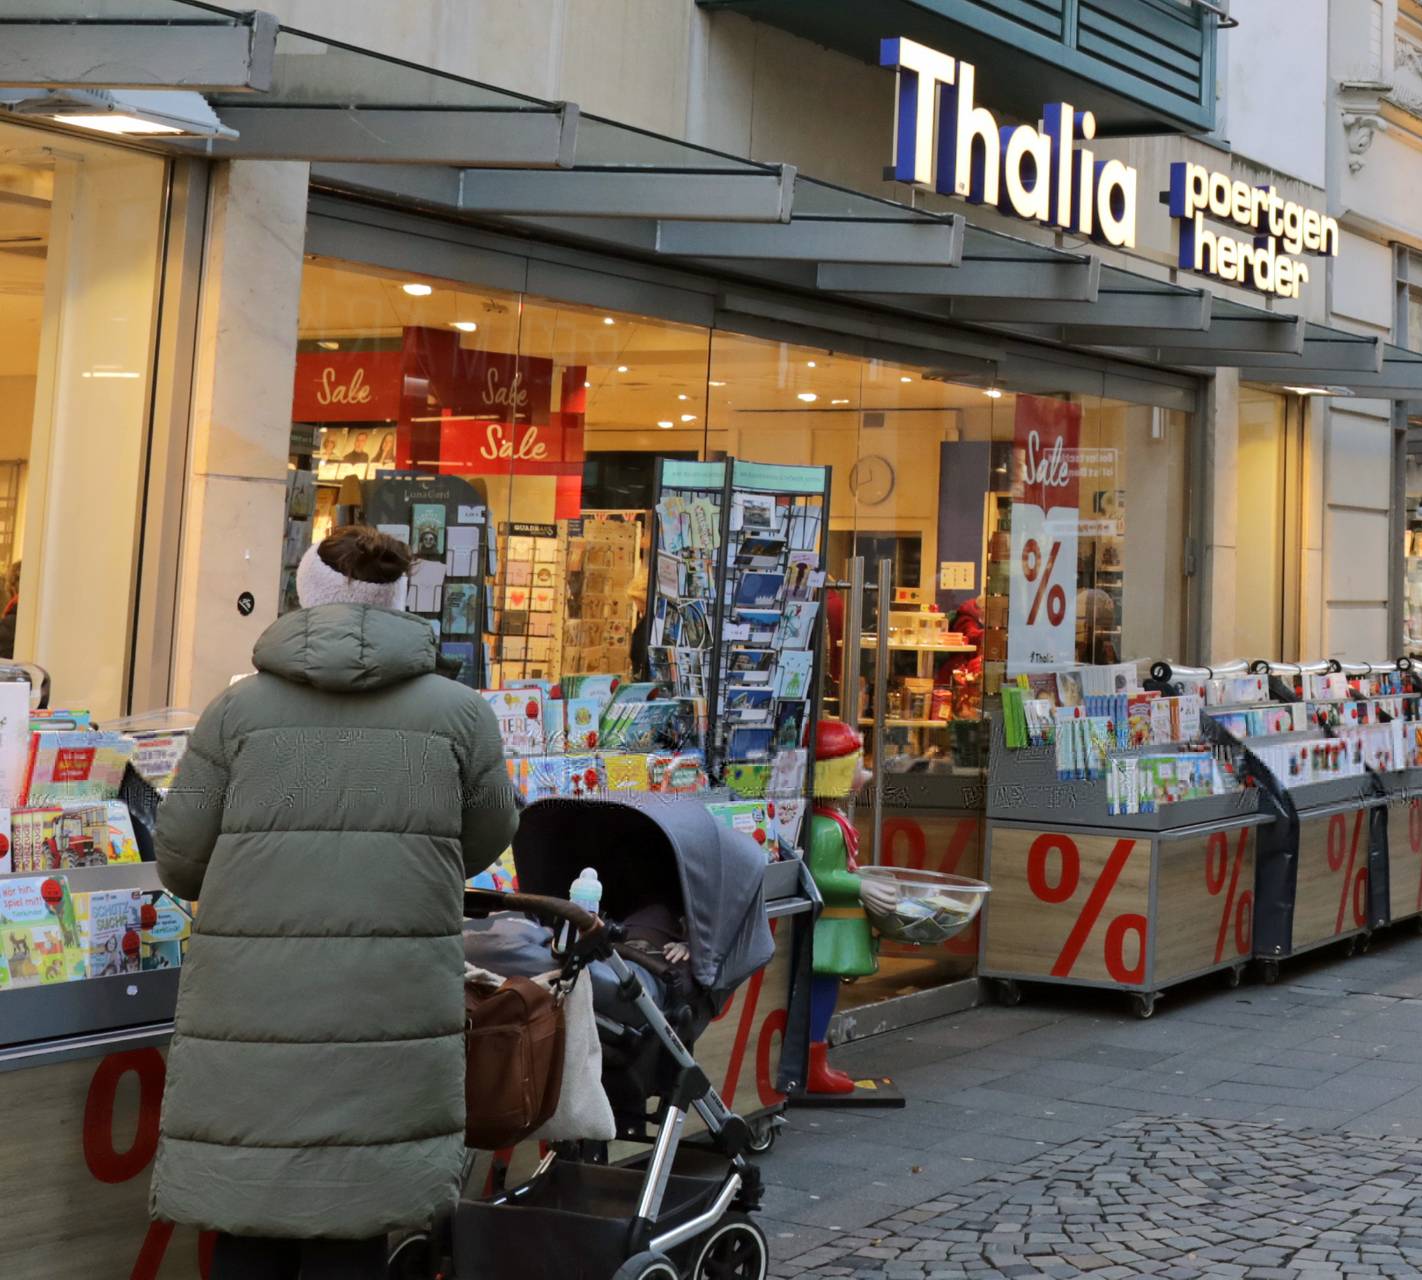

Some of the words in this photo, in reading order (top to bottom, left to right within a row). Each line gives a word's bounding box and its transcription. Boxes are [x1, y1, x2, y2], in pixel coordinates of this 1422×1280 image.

[896, 37, 1137, 248] Thalia
[1185, 162, 1339, 257] poertgen
[1194, 210, 1309, 299] herder
[316, 367, 372, 406] Sale
[481, 367, 530, 407] Sale
[479, 423, 549, 461] Sale
[1022, 430, 1071, 487] Sale
[1026, 833, 1148, 985] %
